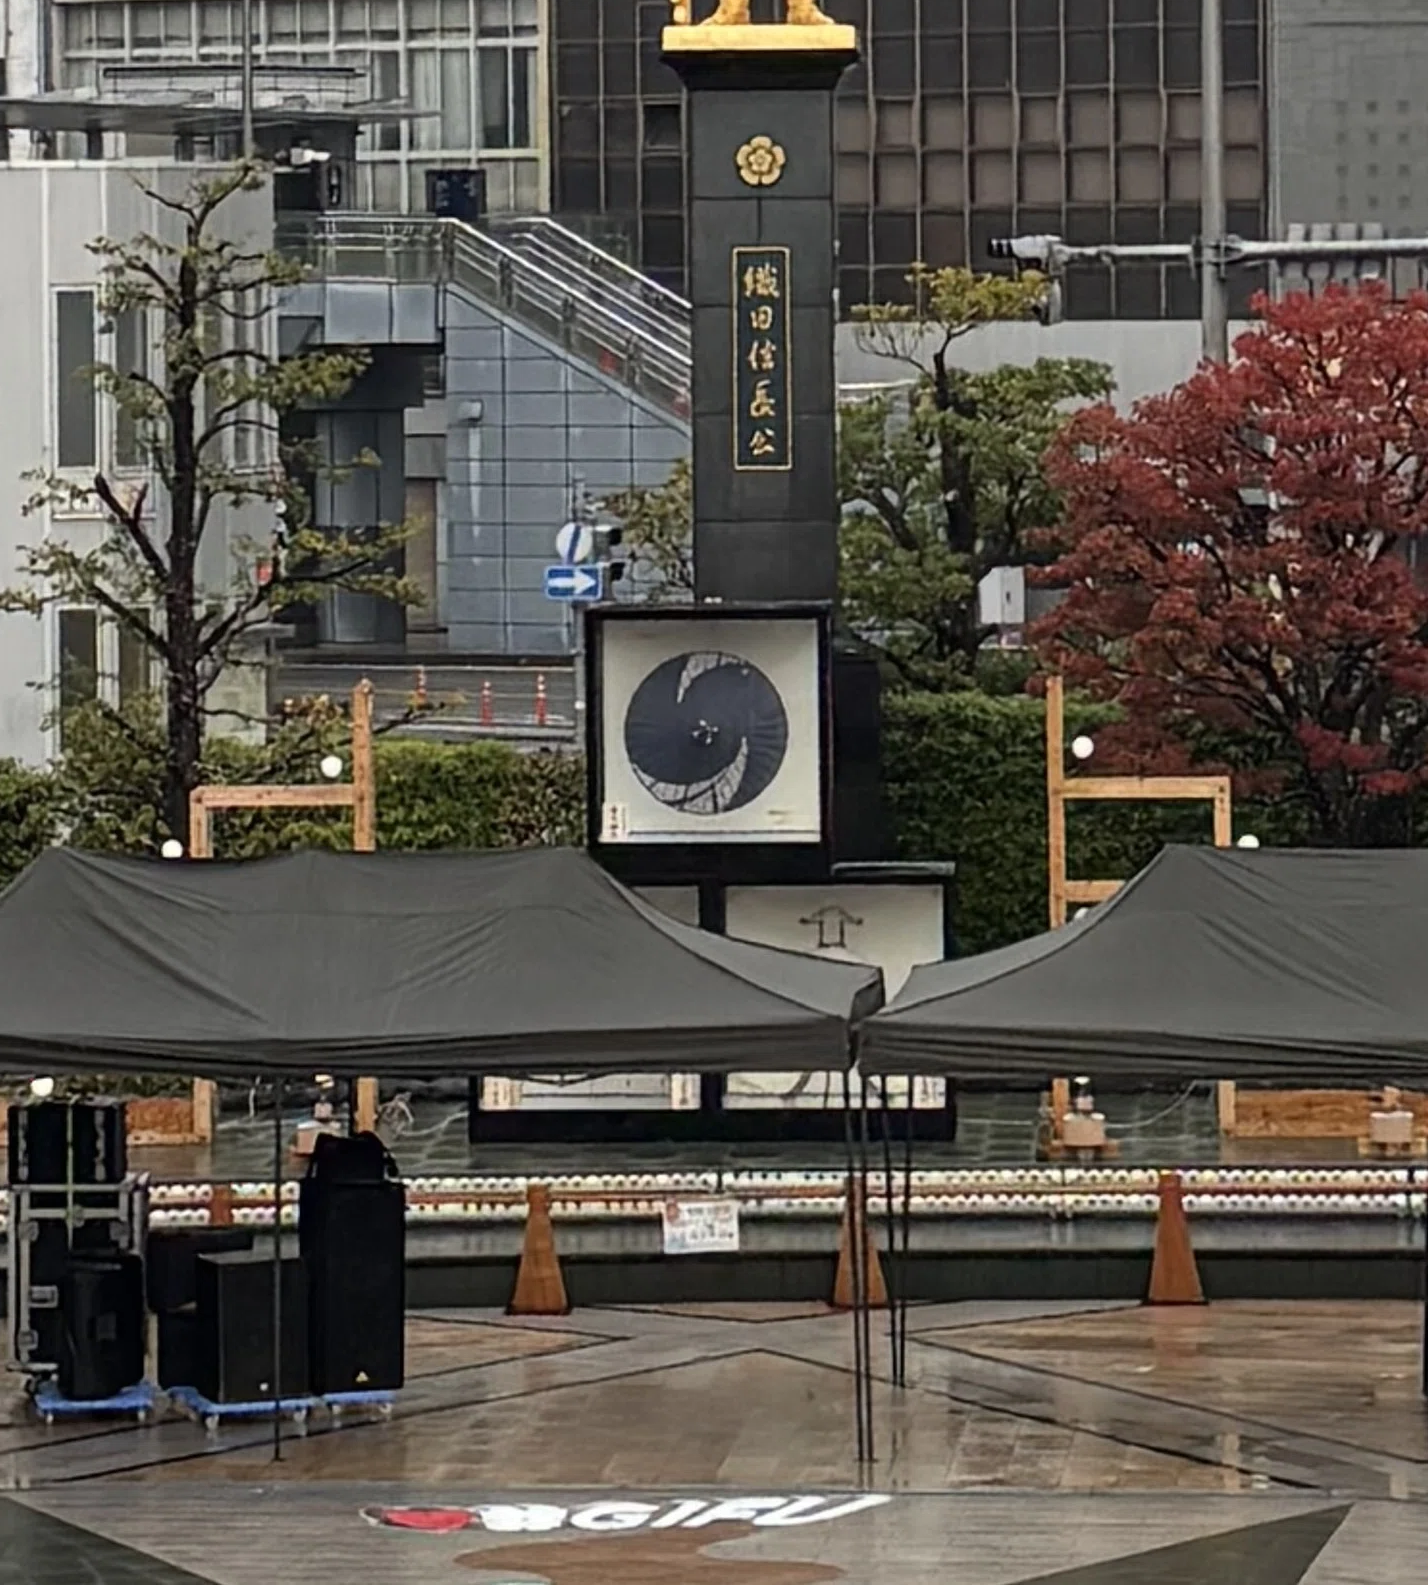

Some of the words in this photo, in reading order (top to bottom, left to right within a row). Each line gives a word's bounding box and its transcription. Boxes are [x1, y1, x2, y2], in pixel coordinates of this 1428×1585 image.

[743, 262, 780, 456] 織田信長公
